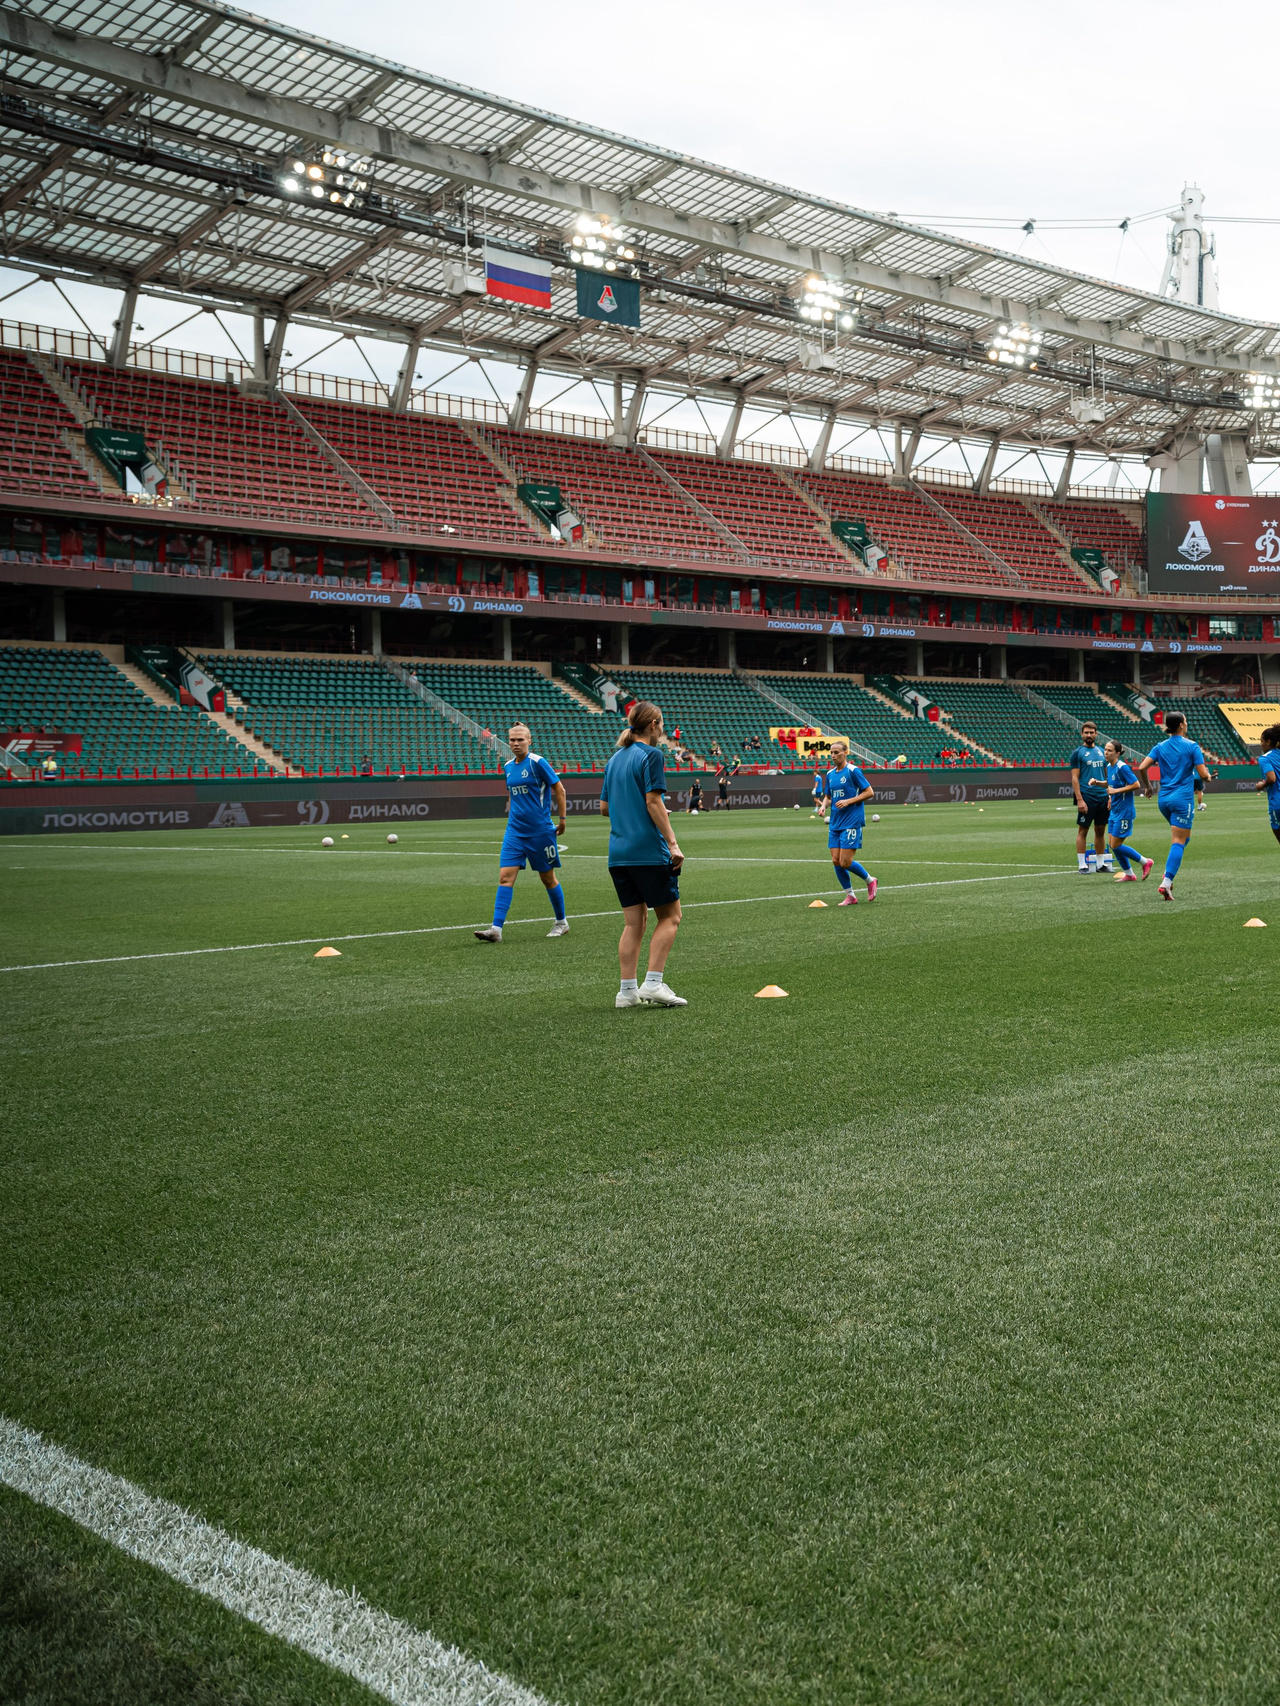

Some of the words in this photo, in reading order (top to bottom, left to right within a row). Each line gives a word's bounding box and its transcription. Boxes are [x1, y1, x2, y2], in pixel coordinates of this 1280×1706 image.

[1165, 563, 1225, 572] ЛОКОМОТИВ
[310, 590, 391, 604] ЛОКОМОТИВ
[473, 601, 524, 613] ДИНАМО
[767, 621, 823, 631] ЛОКОМОТИВ
[879, 628, 916, 637] ДИНАМО
[1092, 641, 1136, 649] ЛОКОМОТИВ
[512, 785, 528, 796] ВТБ
[976, 788, 1019, 798] ДИНАМО
[42, 810, 190, 829] ЛОКОМОТИВ
[349, 803, 430, 820] ДИНАМО
[1120, 819, 1129, 830] 13
[846, 828, 857, 840] 79
[544, 845, 557, 859] 10
